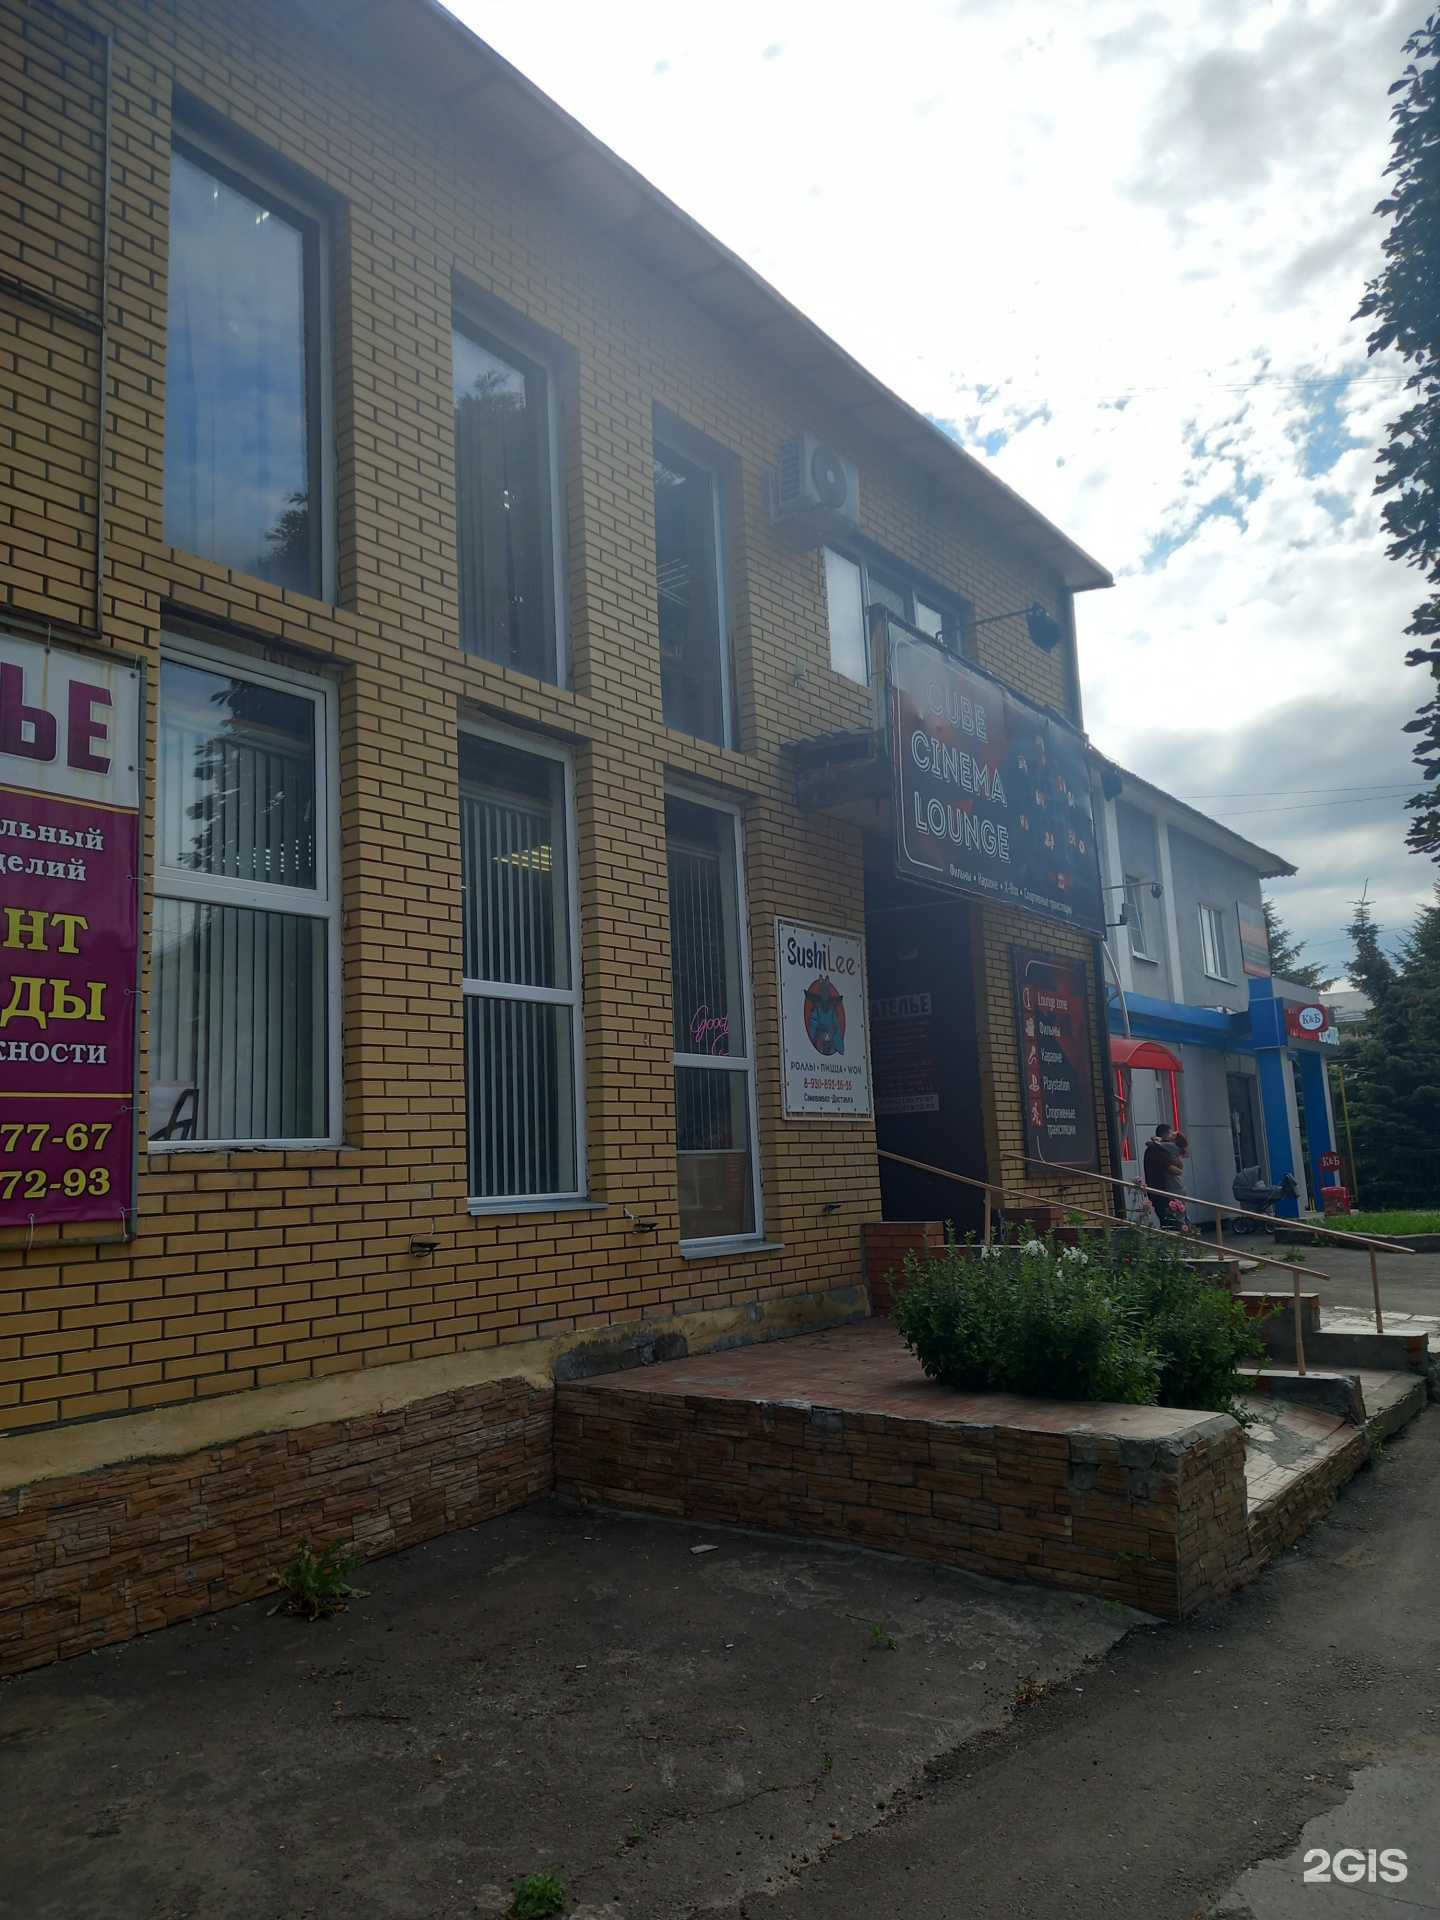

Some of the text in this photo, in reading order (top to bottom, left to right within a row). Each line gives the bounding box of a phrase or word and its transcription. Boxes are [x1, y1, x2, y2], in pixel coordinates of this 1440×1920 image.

[927, 681, 989, 743] CUBE
[911, 729, 1007, 808] CINEMA
[914, 791, 1011, 864] LOUNGE
[790, 1061, 816, 1073] РОЛЛЫ
[820, 1063, 843, 1074] ПИЦЦА
[0, 1122, 113, 1152] 77-67
